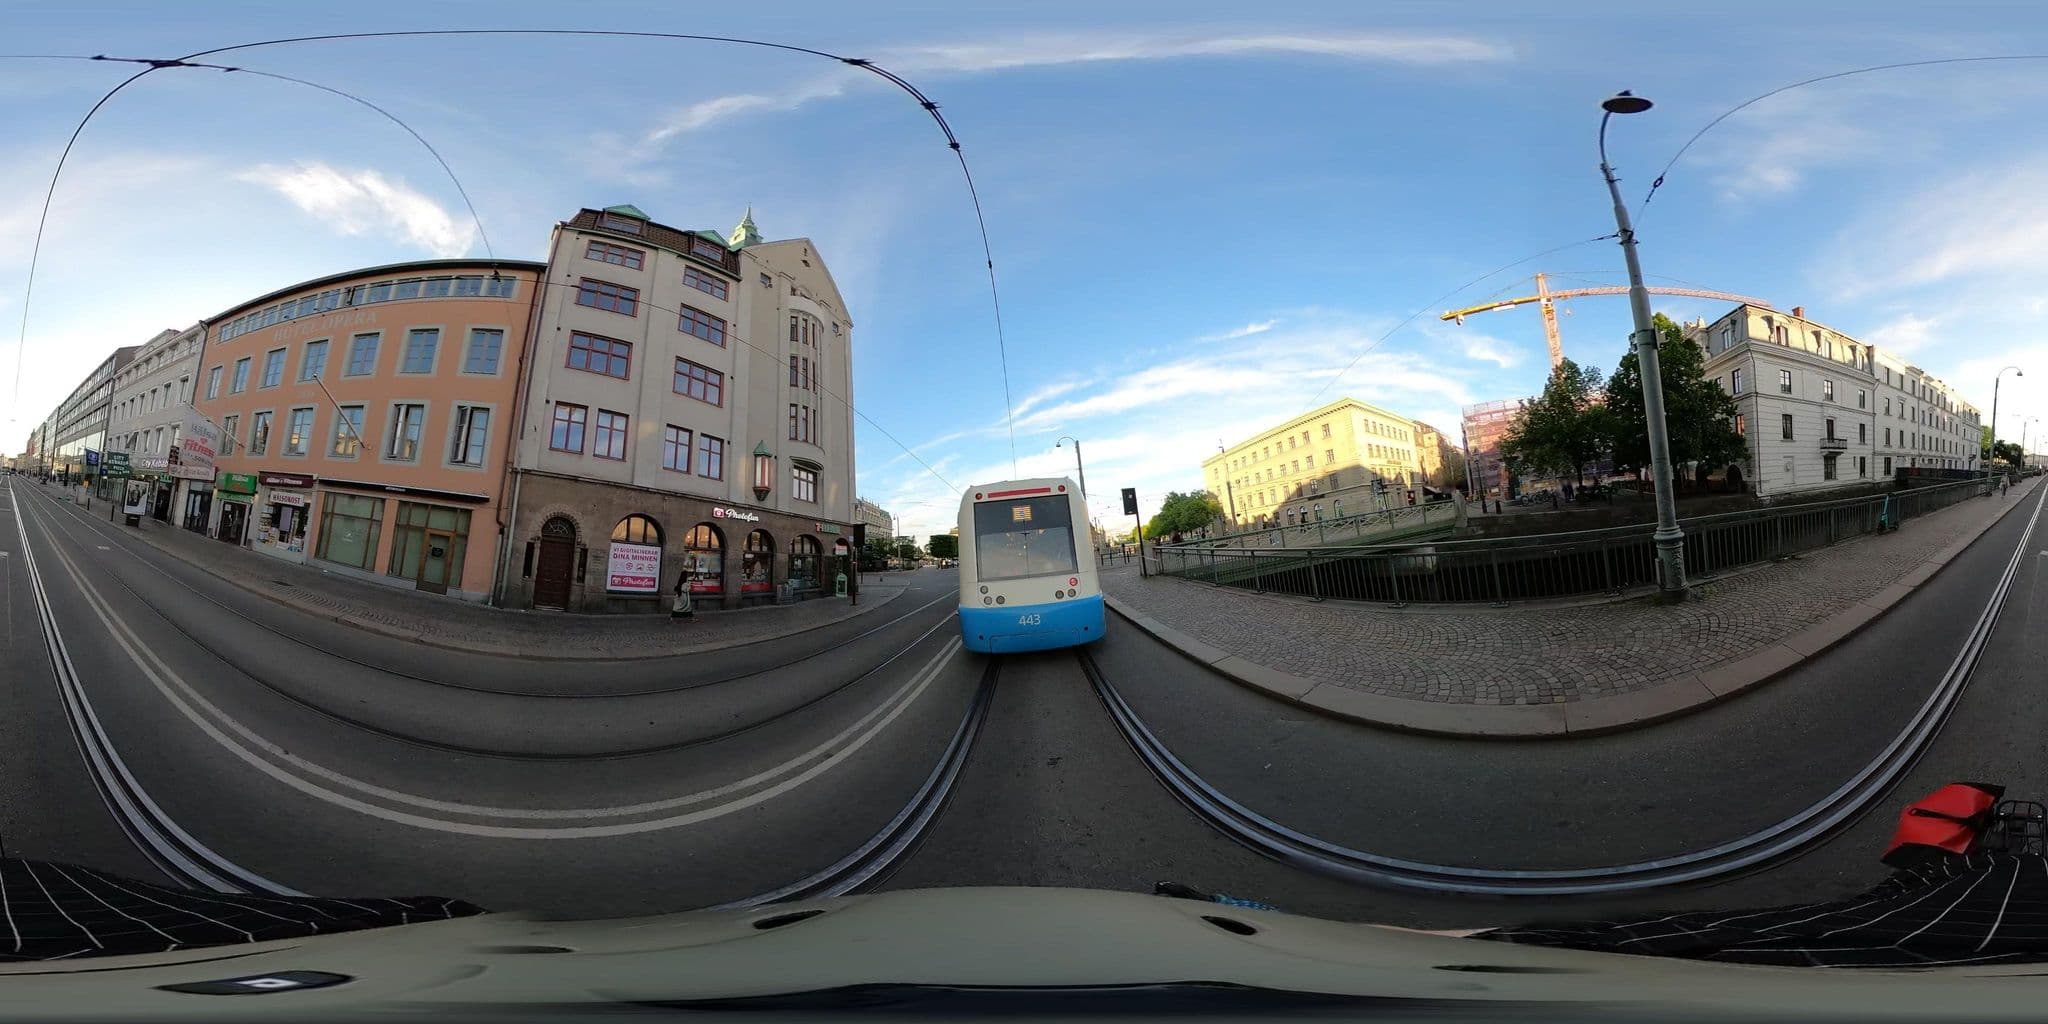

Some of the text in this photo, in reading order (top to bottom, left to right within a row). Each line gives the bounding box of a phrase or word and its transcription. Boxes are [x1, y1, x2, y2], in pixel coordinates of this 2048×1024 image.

[725, 508, 759, 522] Photofun
[632, 554, 658, 562] MINNEN
[1018, 614, 1041, 626] 443
